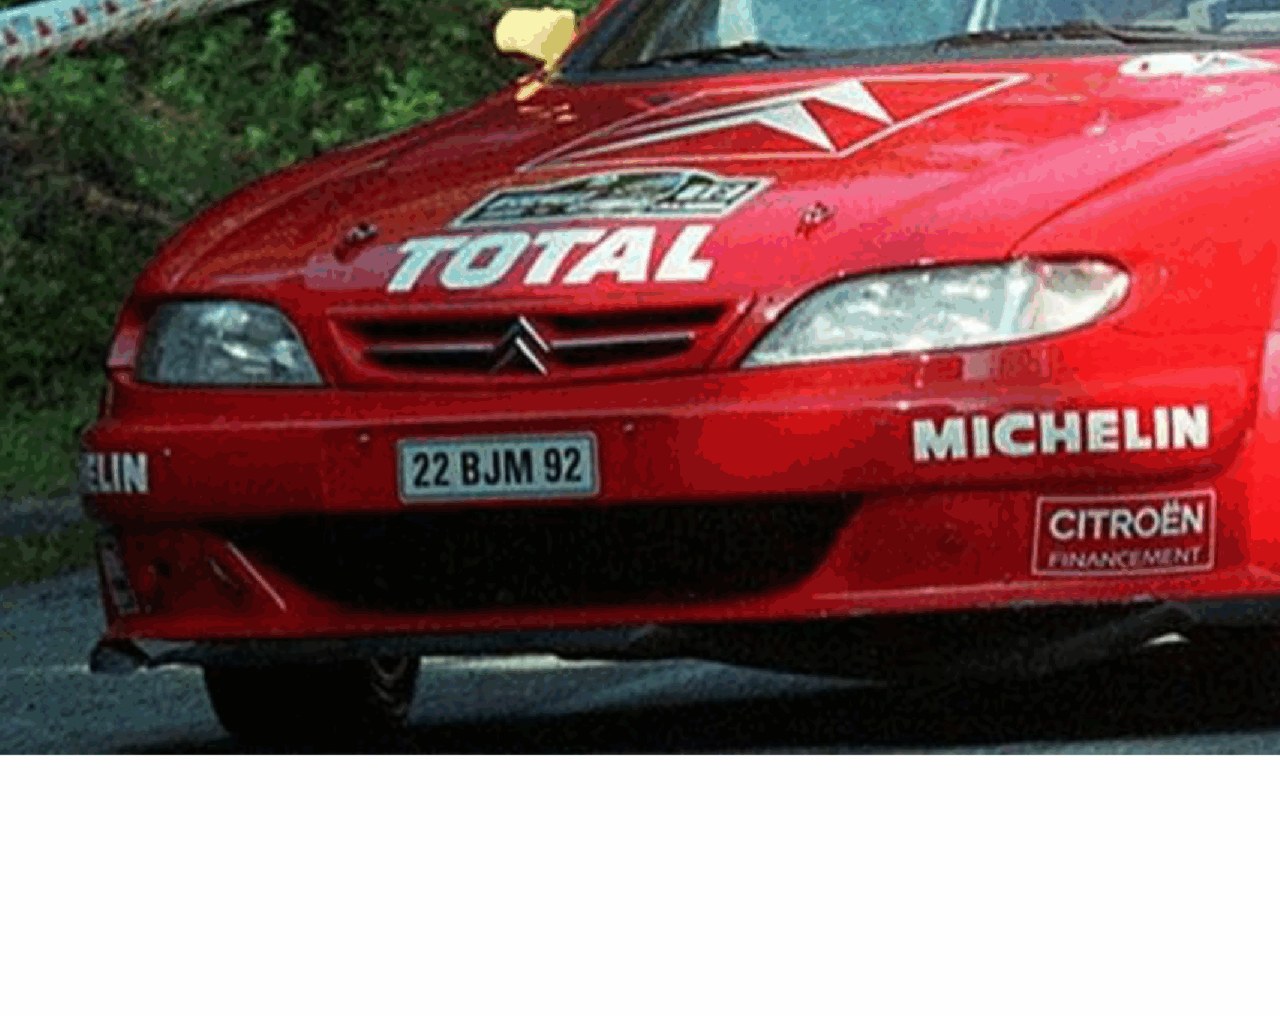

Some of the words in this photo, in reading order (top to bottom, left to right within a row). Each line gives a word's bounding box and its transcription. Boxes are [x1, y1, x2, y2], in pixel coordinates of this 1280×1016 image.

[387, 224, 714, 293] TOTAL
[913, 405, 1209, 462] MICHELIN
[413, 451, 450, 488] 22
[460, 448, 534, 486] BJM
[544, 447, 582, 482] 92
[1049, 499, 1205, 541] CITROËN
[1048, 546, 1203, 569] FINANCEMENT
